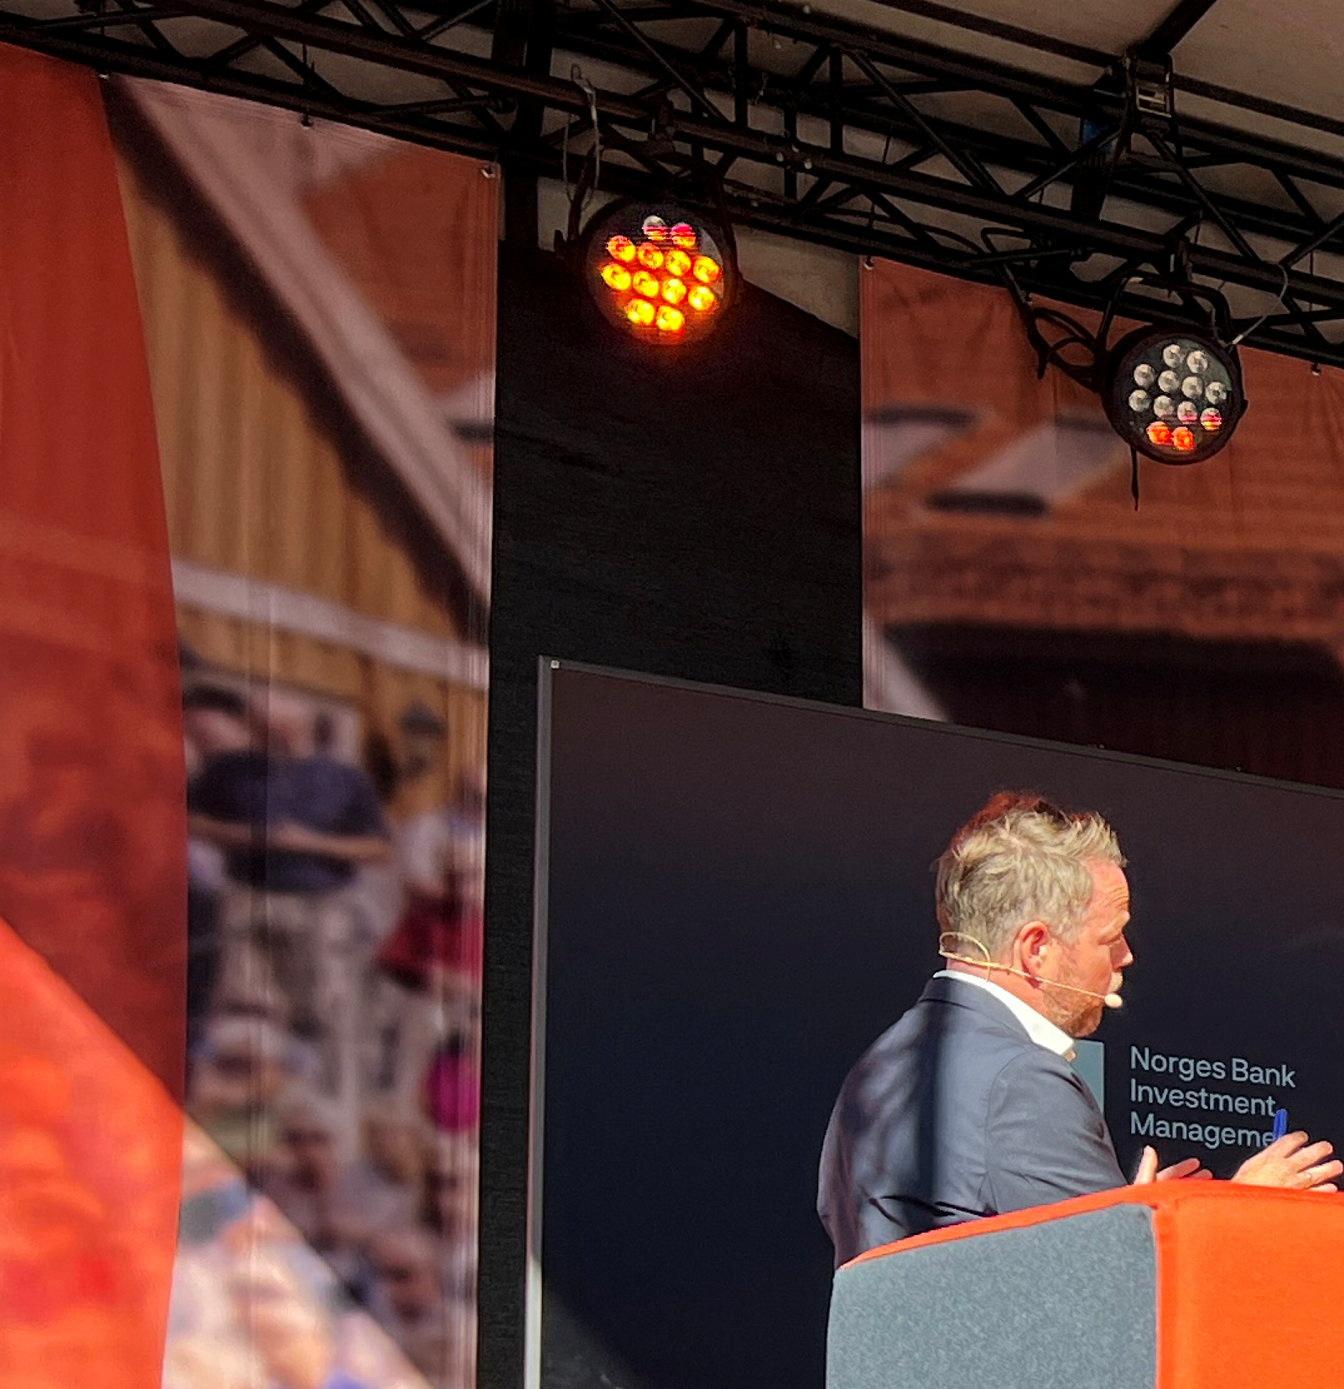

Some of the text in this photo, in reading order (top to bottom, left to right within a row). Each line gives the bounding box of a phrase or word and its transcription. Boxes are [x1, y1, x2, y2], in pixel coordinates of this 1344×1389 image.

[1130, 1045, 1297, 1089] Norges Bank
[1130, 1078, 1277, 1117] Investment
[1130, 1111, 1275, 1150] Manageme
